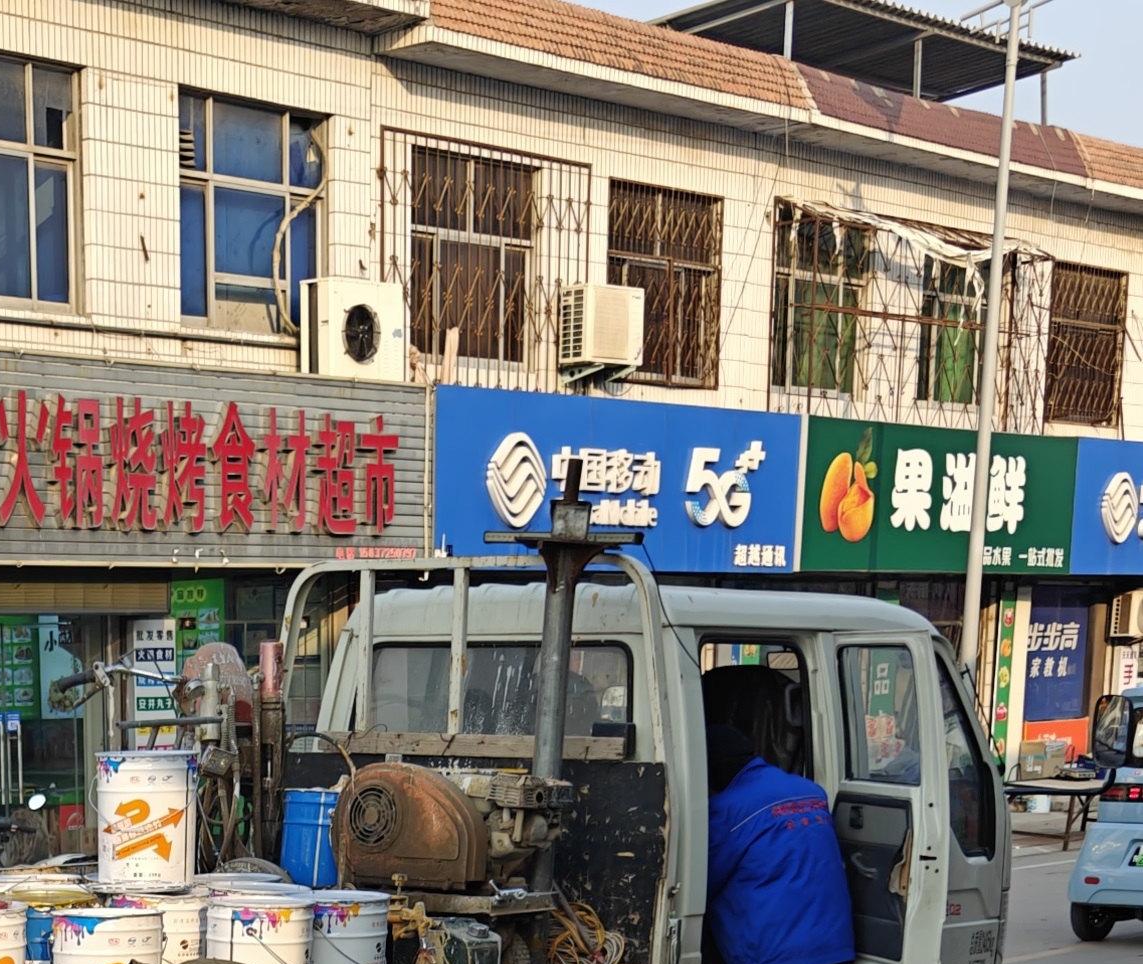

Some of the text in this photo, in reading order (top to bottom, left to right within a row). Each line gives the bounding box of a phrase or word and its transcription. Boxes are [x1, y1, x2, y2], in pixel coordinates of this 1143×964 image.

[551, 445, 661, 497] 中国移动
[982, 546, 1012, 566] 品水果
[136, 629, 174, 641] 批发零售
[1026, 620, 1080, 652] 步步高
